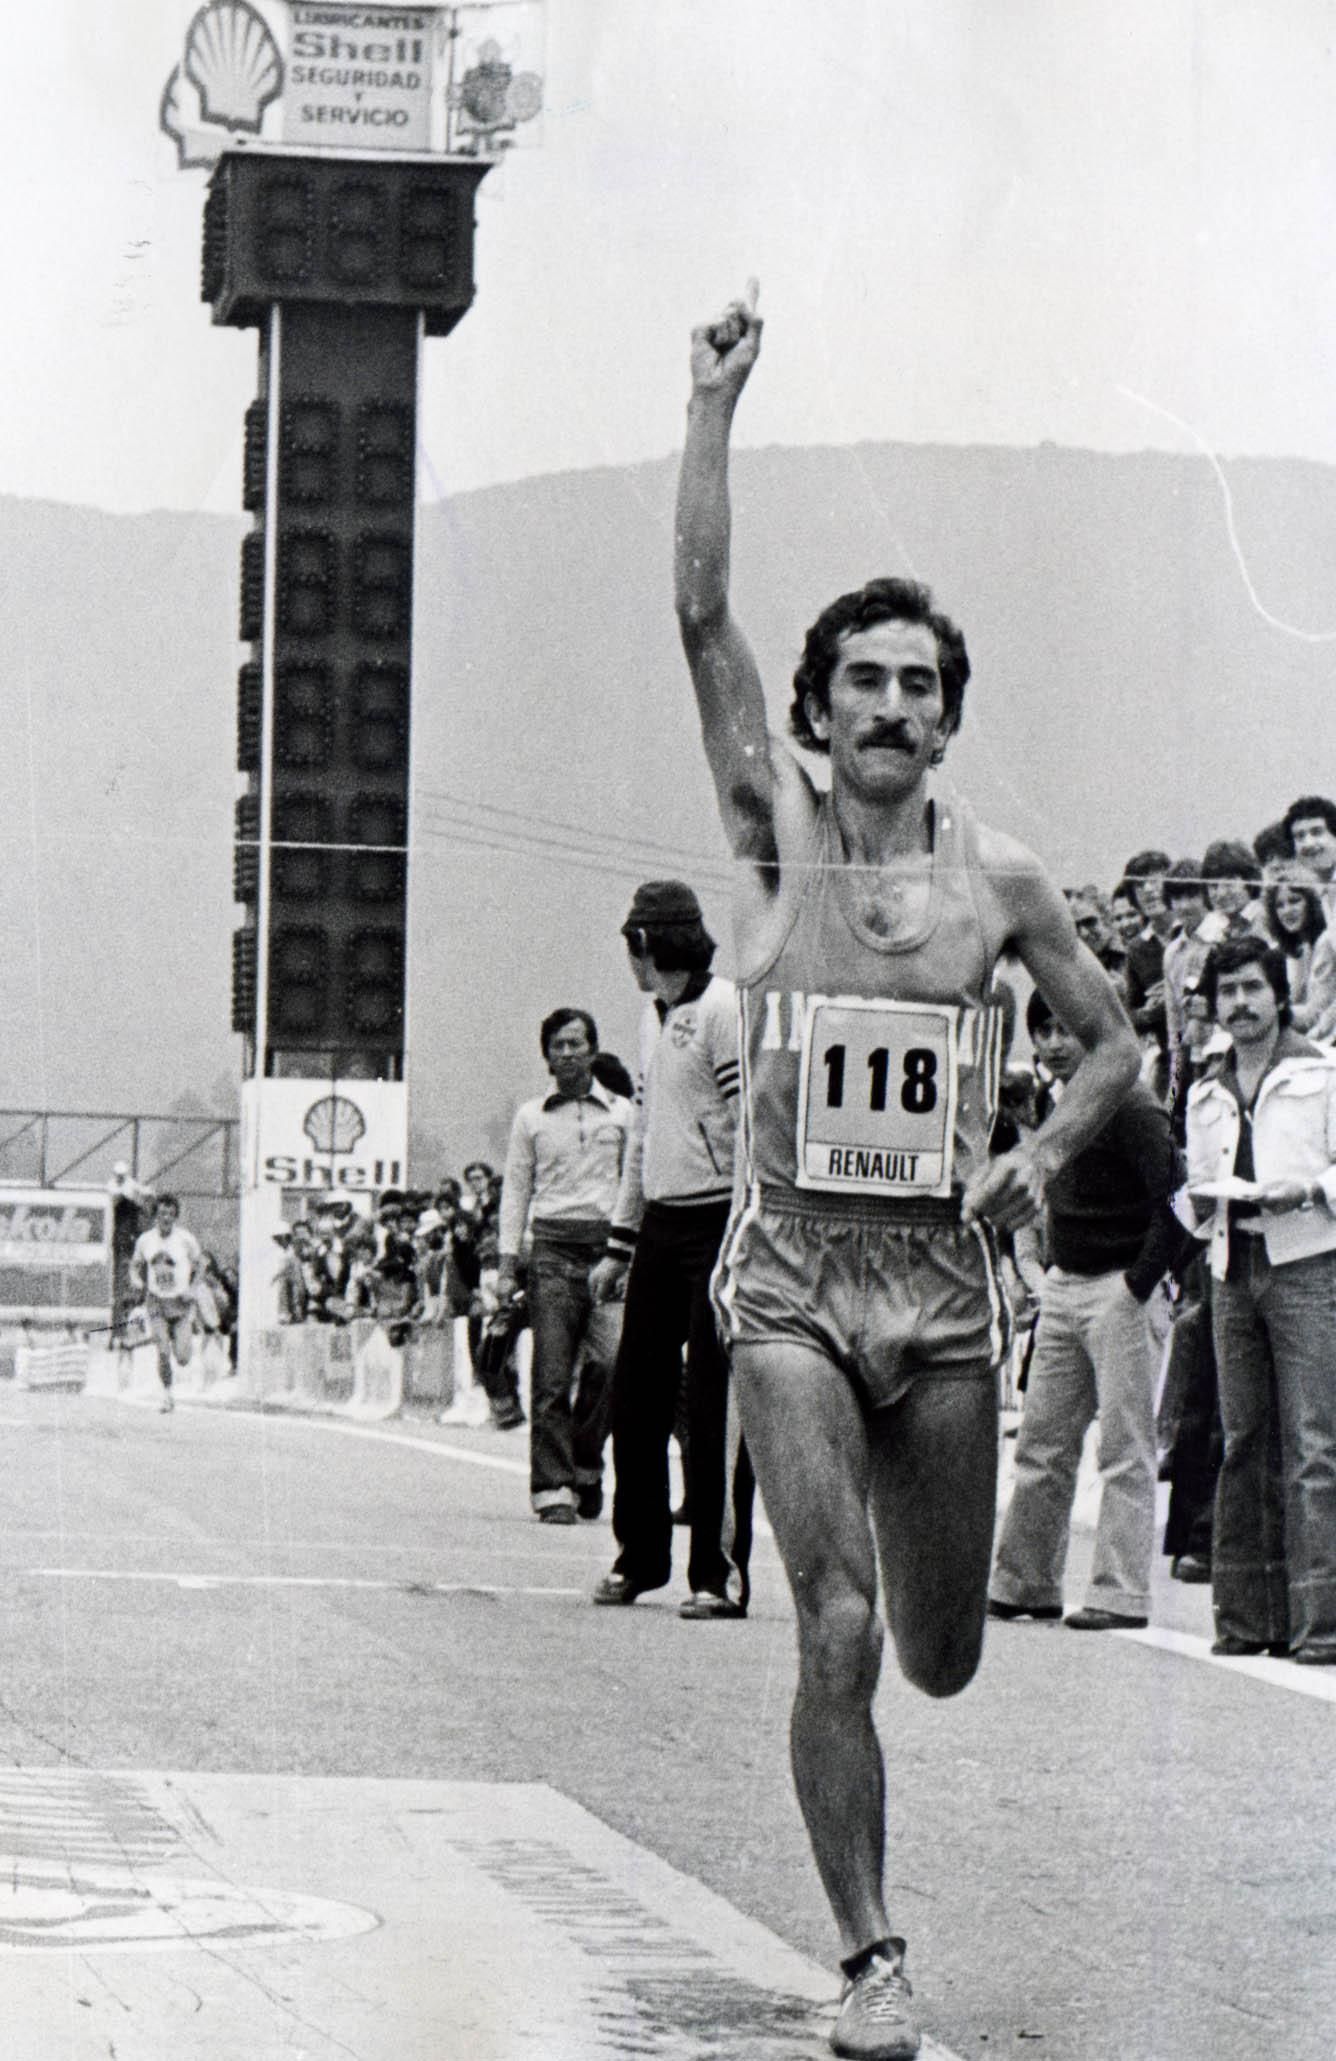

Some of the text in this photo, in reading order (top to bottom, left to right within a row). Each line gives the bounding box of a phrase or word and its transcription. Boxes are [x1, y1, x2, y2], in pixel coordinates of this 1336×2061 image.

[293, 33, 422, 63] Shell
[291, 66, 420, 90] SEGURIDAD
[352, 93, 363, 104] Y
[302, 108, 409, 127] SERVICIO
[824, 1044, 938, 1114] 118
[264, 1156, 401, 1186] Shell
[829, 1149, 919, 1182] RENAULT
